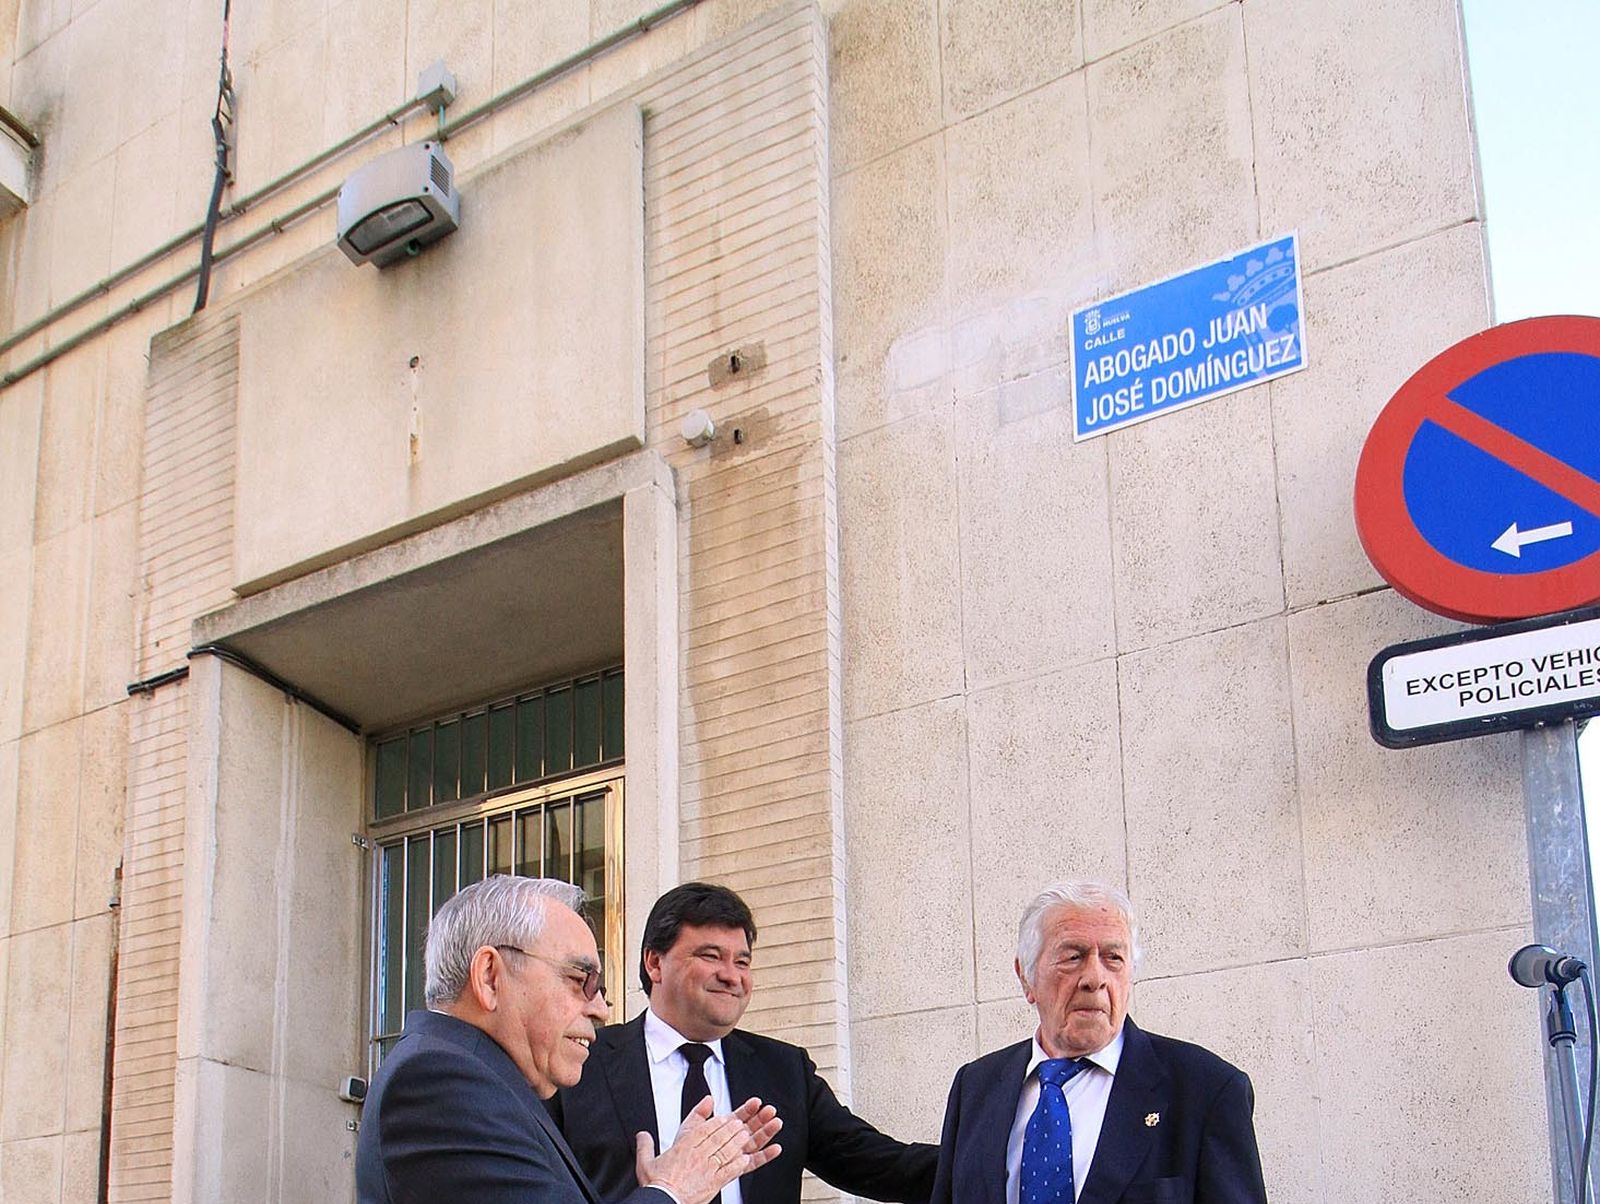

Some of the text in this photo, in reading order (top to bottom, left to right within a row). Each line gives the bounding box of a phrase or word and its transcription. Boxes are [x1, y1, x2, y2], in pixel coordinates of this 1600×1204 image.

[1084, 328, 1126, 351] CALLE
[1084, 303, 1268, 388] ABOGADO JUAN
[1085, 334, 1297, 425] JOSÉ DOMÍNGUEZ
[1406, 661, 1524, 696] EXCEPTO
[1459, 668, 1600, 707] POLICIALE
